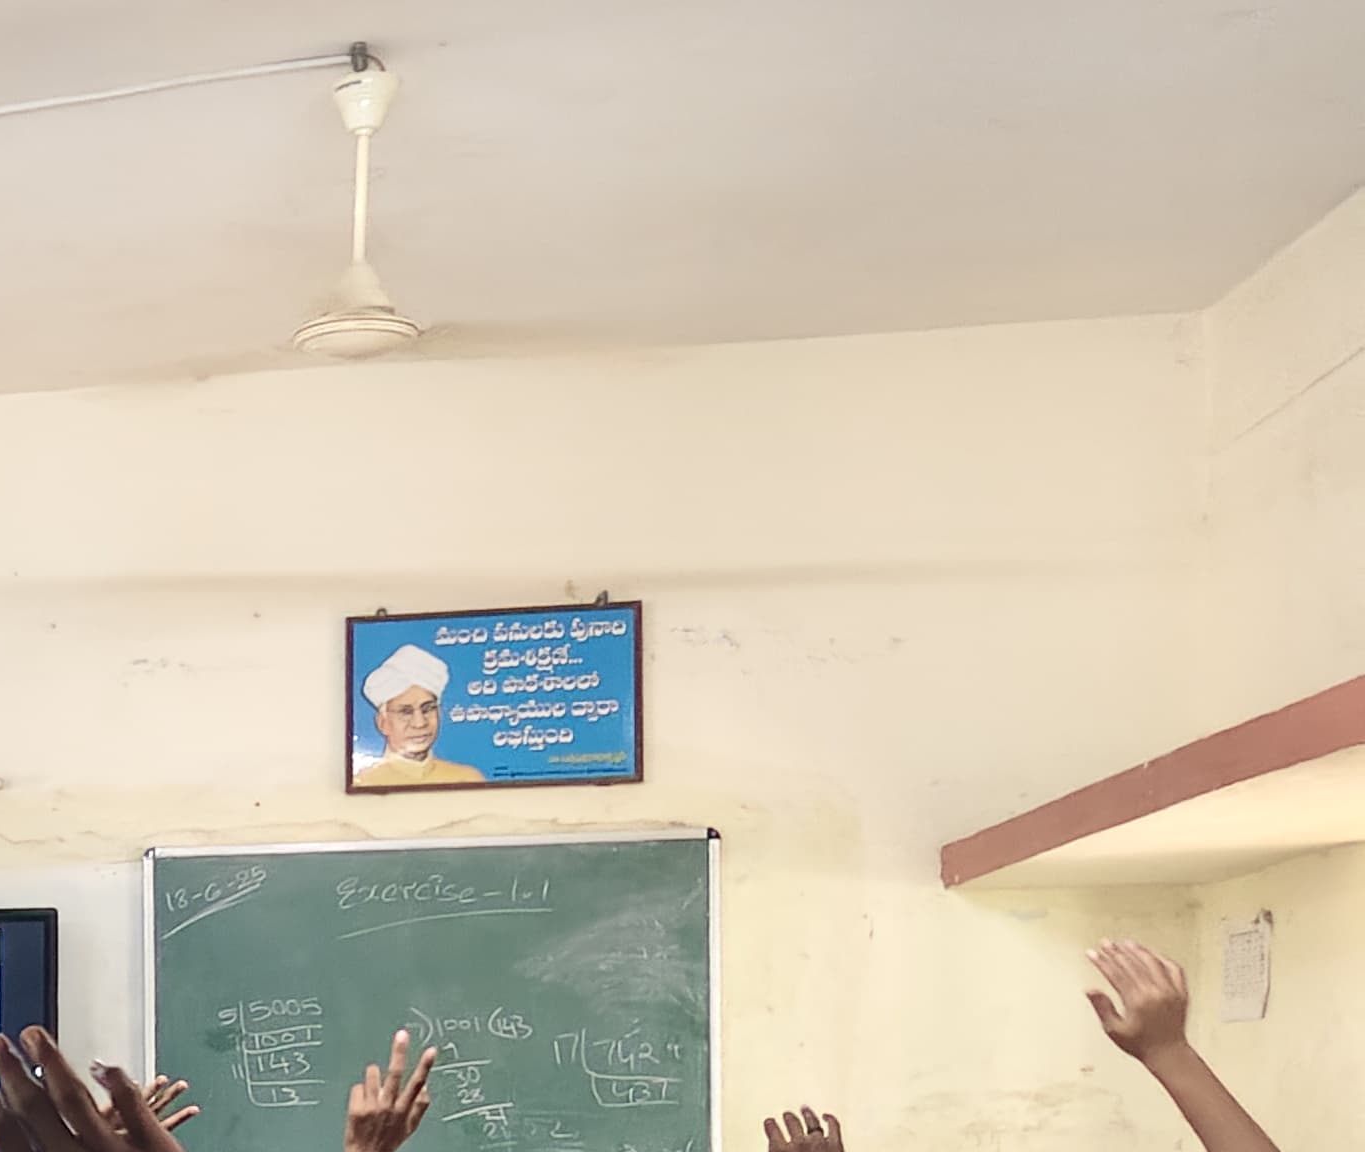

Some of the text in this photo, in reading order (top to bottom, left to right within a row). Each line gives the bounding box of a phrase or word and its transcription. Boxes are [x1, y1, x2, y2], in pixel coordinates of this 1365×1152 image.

[493, 620, 565, 642] పనులకు
[570, 617, 627, 641] పునాది
[467, 678, 497, 695] అది
[450, 700, 619, 726] ఉపాధ్యాయుల ద్వారా
[493, 725, 574, 751] లభిస్తుంది
[248, 997, 323, 1021] 5005
[257, 1051, 311, 1076] 143
[271, 1087, 300, 1104] 13
